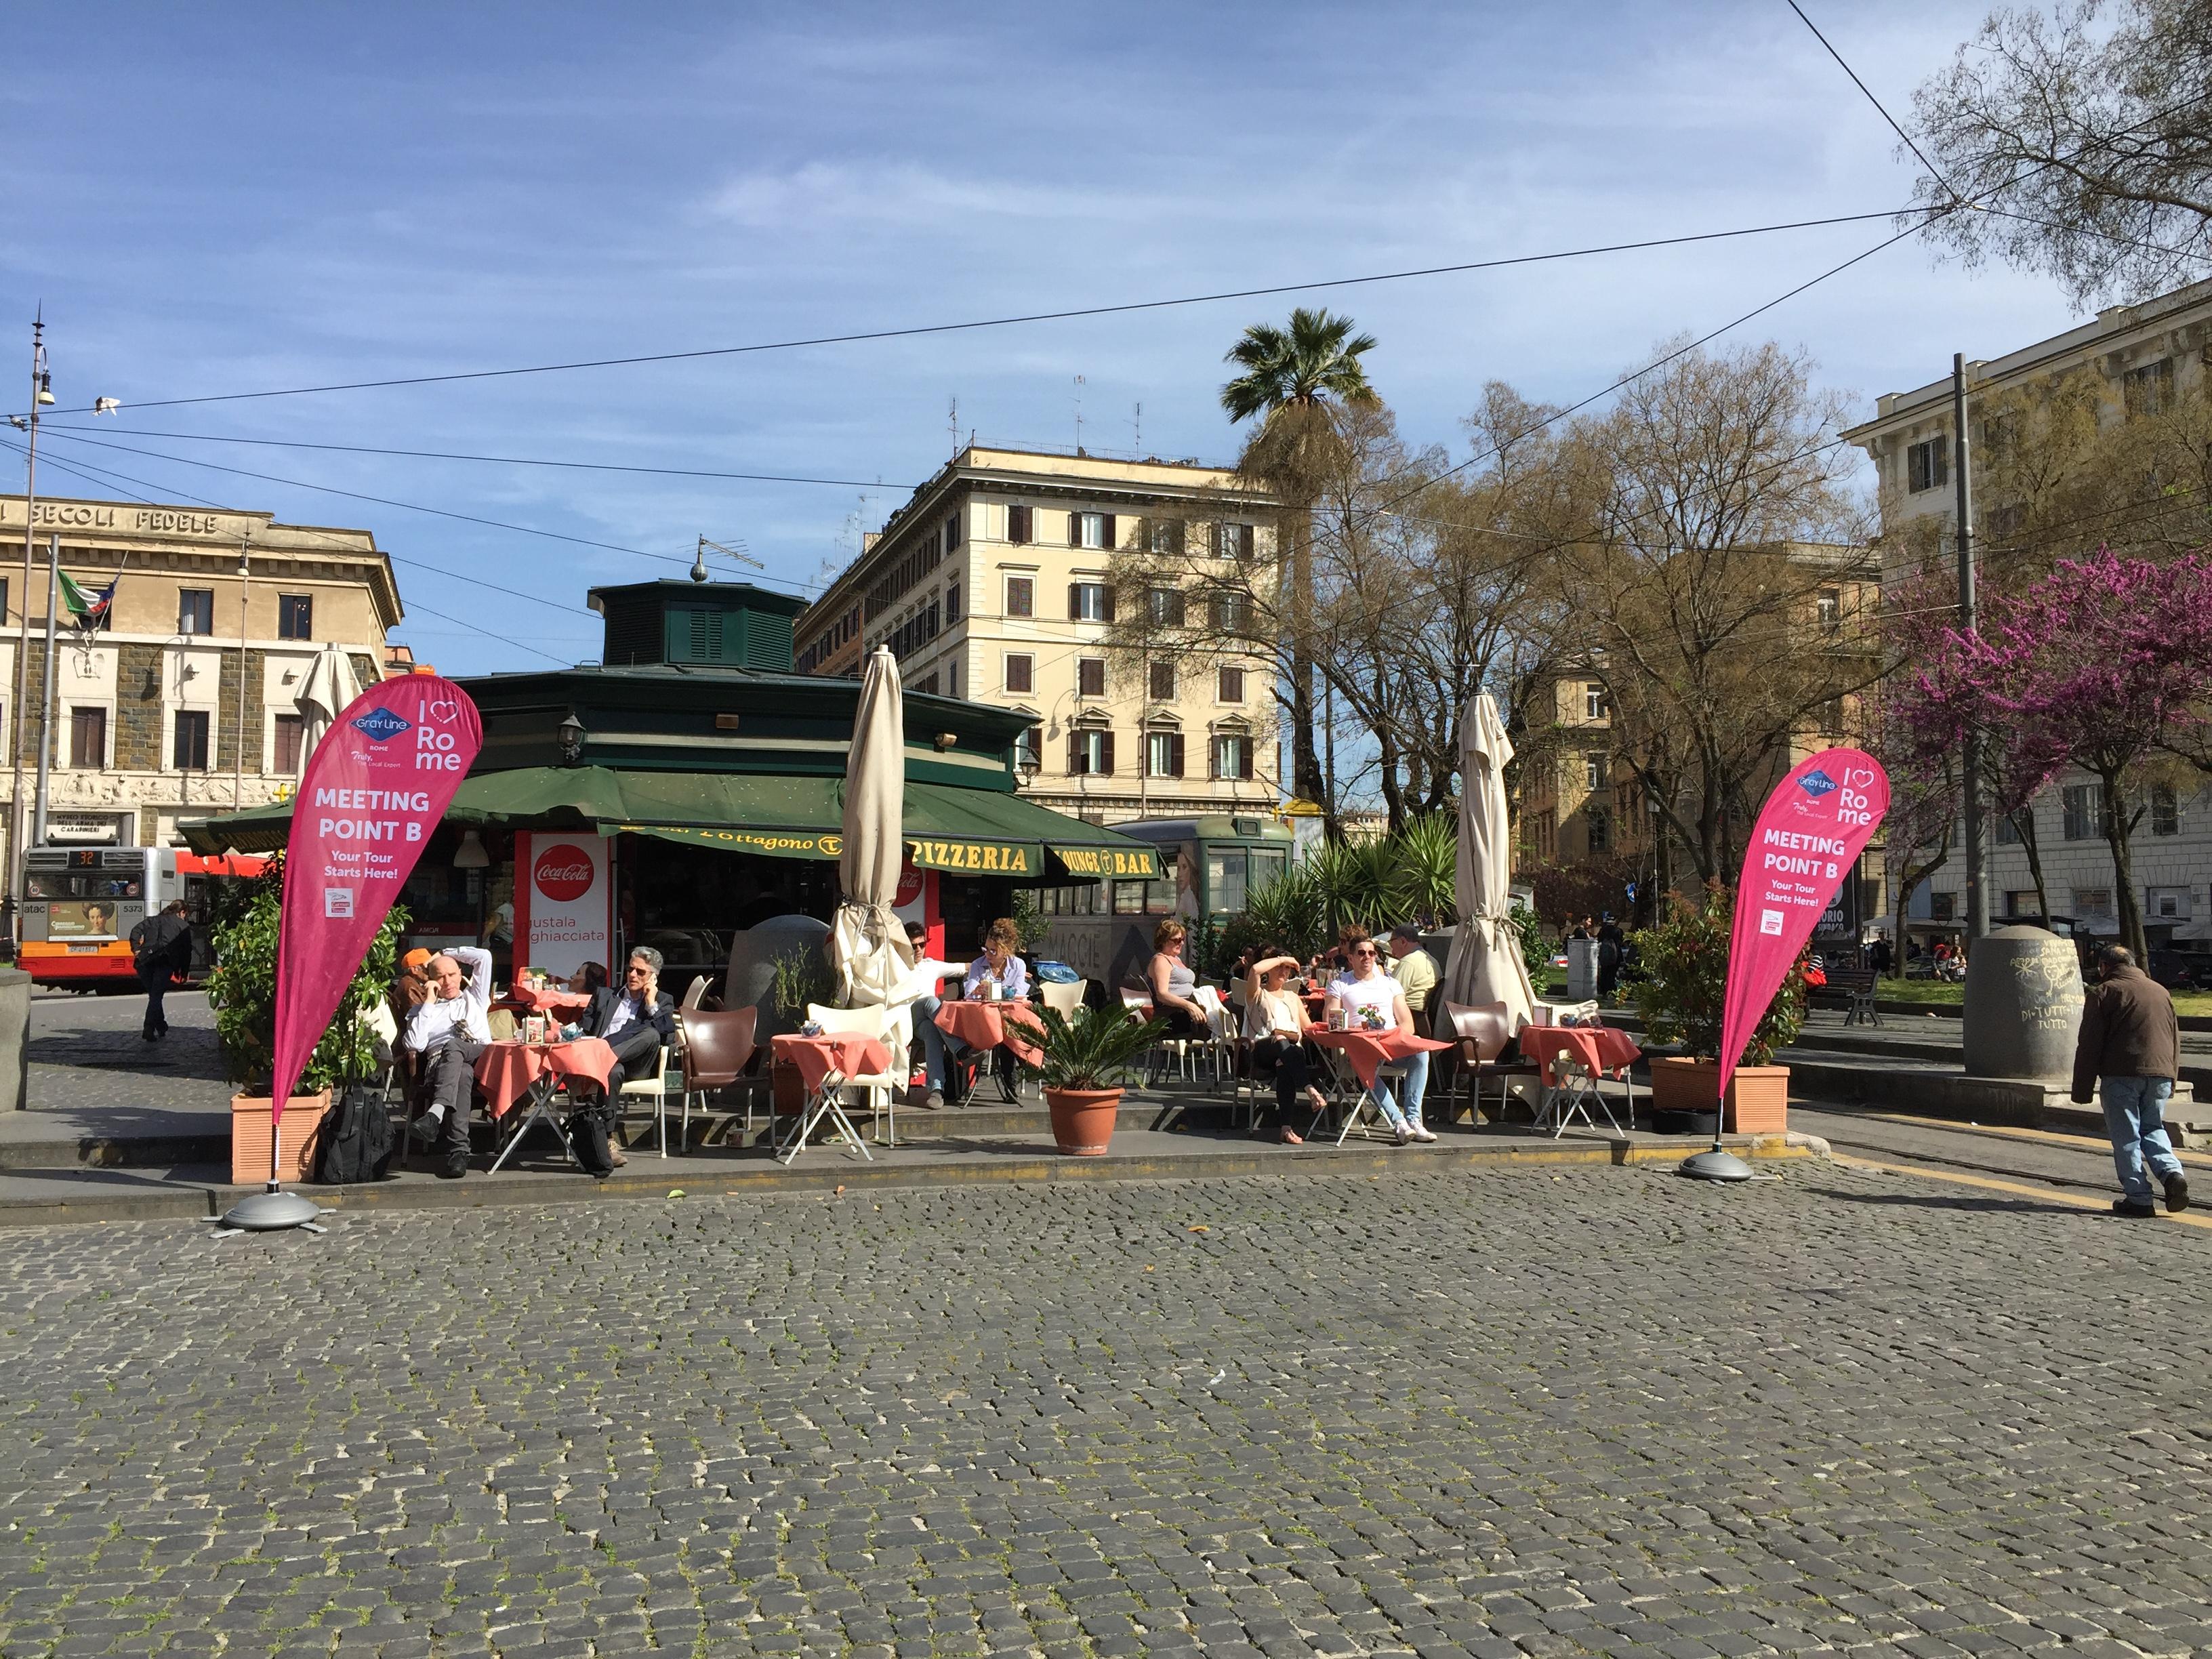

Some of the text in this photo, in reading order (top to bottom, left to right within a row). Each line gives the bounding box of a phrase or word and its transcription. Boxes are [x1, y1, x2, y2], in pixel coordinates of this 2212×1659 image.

[136, 510, 219, 533] FEDELE
[356, 718, 383, 729] Gray
[417, 726, 455, 751] Ro
[415, 752, 462, 771] me
[314, 787, 430, 812] MEETING
[1839, 787, 1869, 810] Ro
[1837, 808, 1872, 826] me
[319, 818, 422, 842] POINT B
[1763, 828, 1845, 857] MEETING
[80, 851, 94, 865] 32
[331, 850, 393, 863] Your Tour
[906, 840, 1028, 872] PIZZERIA
[1115, 853, 1153, 874] BAR
[324, 865, 398, 879] Starts Here!
[1764, 853, 1838, 879] POINT B
[1771, 879, 1816, 895] Your Tour
[1765, 891, 1792, 904] Starts
[1793, 895, 1819, 907] Here!
[24, 905, 45, 914] atac
[123, 905, 143, 913] 5373
[531, 930, 605, 944] ghiacciata
